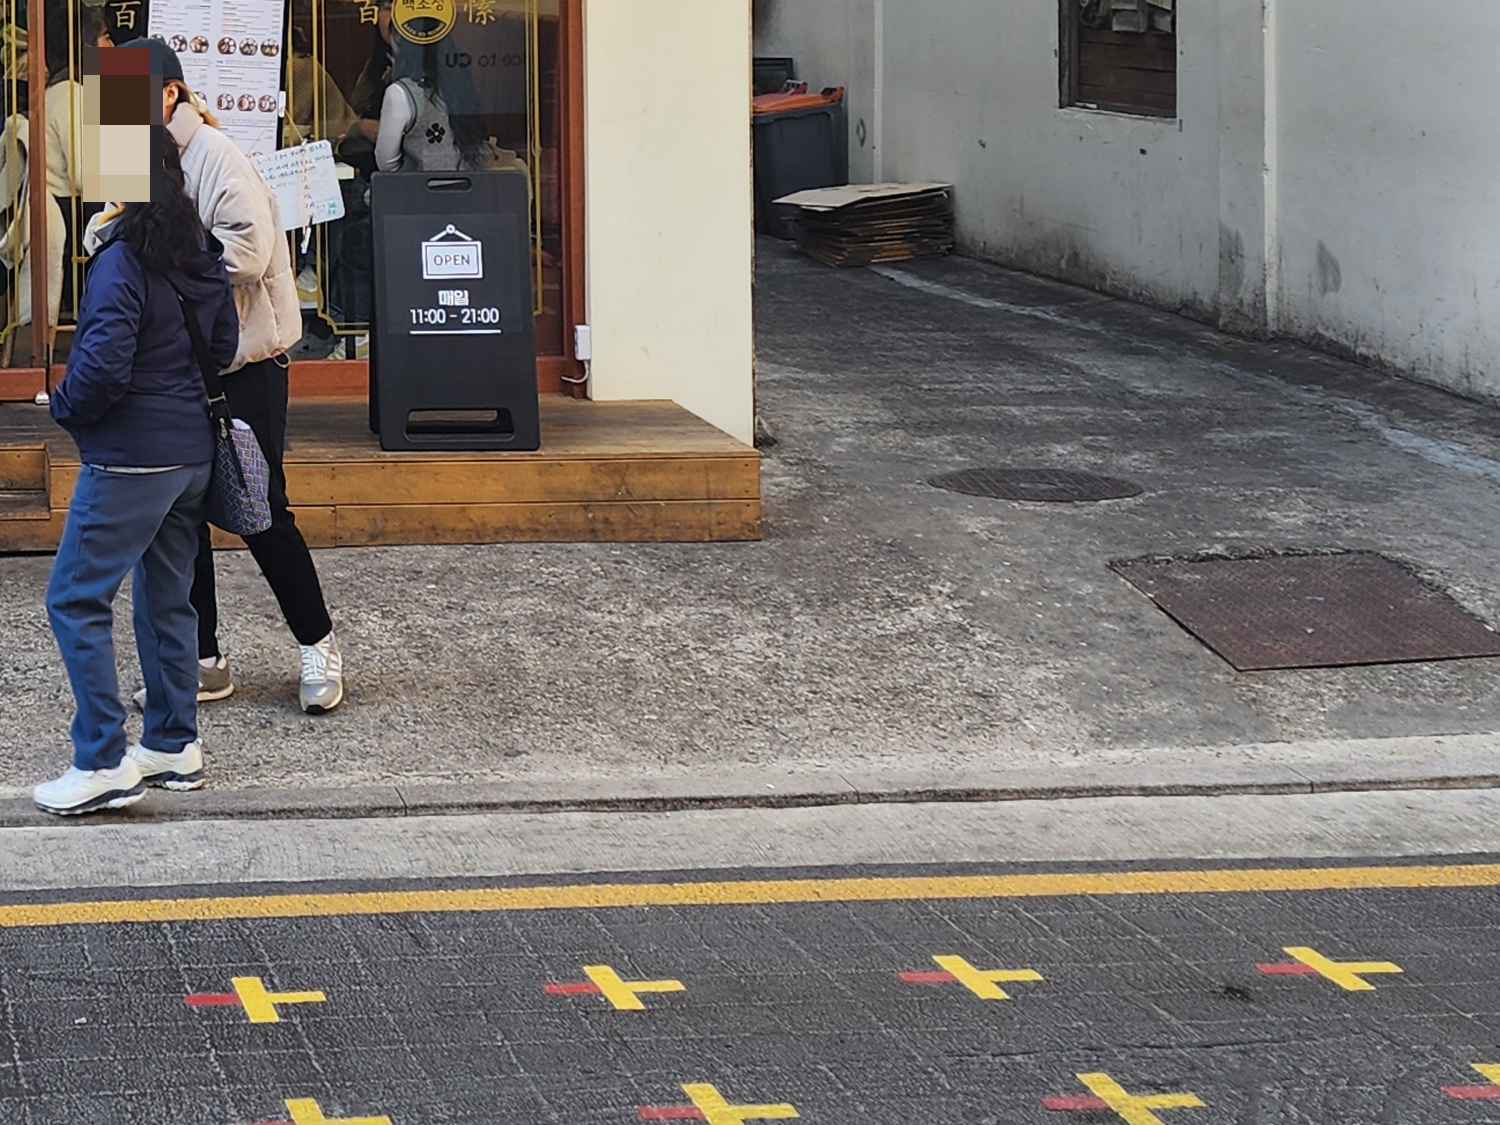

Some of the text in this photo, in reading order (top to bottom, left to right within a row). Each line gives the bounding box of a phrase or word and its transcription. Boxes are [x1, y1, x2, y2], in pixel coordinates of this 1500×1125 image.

[109, 0, 141, 30] 百
[433, 254, 470, 266] OPEN
[438, 290, 469, 306] 매일
[410, 308, 446, 324] 11:00
[461, 308, 499, 324] 21:00
